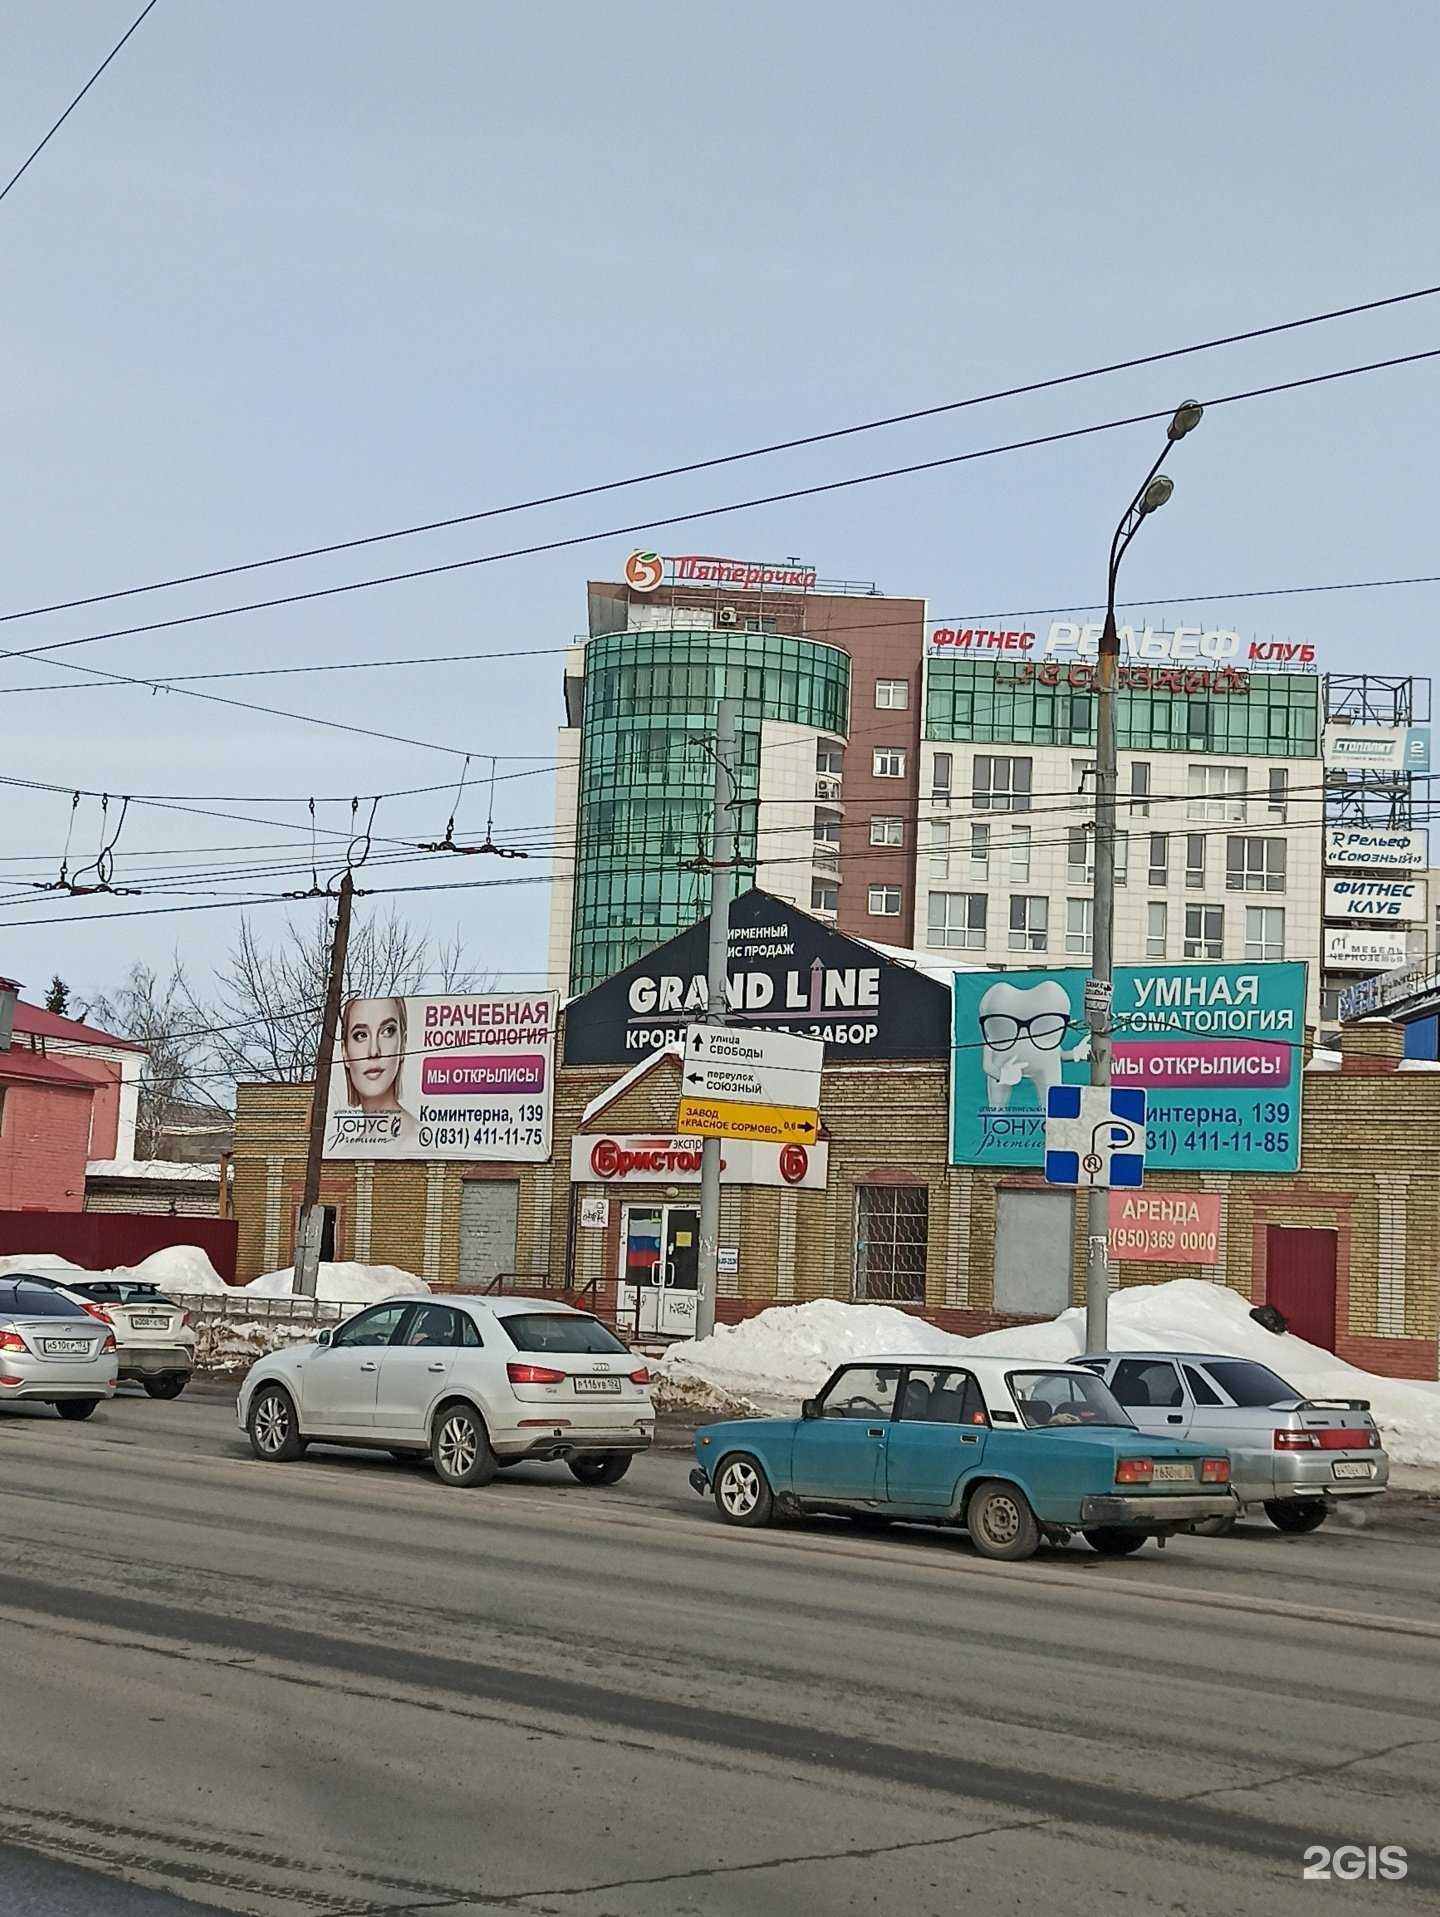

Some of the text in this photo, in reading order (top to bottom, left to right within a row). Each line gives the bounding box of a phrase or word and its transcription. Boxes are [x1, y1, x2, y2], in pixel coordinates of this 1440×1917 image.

[933, 622, 1316, 663] ФИТНЕС РЕЛЬЕФ КЛУБ
[1347, 834, 1411, 849] Рельеф
[1328, 850, 1422, 864] «Союзный»
[1333, 882, 1415, 898] ФИТНЕС
[1347, 900, 1402, 915] КЛУБ
[727, 924, 788, 939] ИРМЕННЫЙ
[744, 942, 794, 959] ПРОДАЖ
[628, 956, 880, 1013] GRAND LINE
[1133, 976, 1258, 1008] УМНАЯ
[425, 1002, 549, 1027] ВРАЧЕБНАЯ
[424, 1028, 548, 1047] КОСМЕТОЛОГИЯ
[710, 1035, 740, 1044] улица
[709, 1045, 763, 1059] СВОБОДЫ
[1112, 1057, 1280, 1075] МЫ ОТКРЫЛИСЬ!
[427, 1067, 539, 1084] МЫ ОТКРЫЛИСЬ!
[707, 1071, 754, 1081] переулок
[706, 1081, 762, 1094] СОЮЗНЫЙ
[420, 1104, 543, 1125] Коминтерна, 139
[686, 1108, 719, 1119] ЗАВОД
[1147, 1103, 1290, 1127] интерна, 139
[333, 1115, 388, 1133] ТОНУС
[681, 1119, 729, 1131] «КРАСНОЕ
[731, 1123, 783, 1134] СОРМОВО»
[435, 1127, 542, 1148] (831) 411-11-75
[1184, 1131, 1289, 1152] 411-11-85
[1122, 1199, 1200, 1226] АРЕНДА
[1180, 1231, 1216, 1250] 0000
